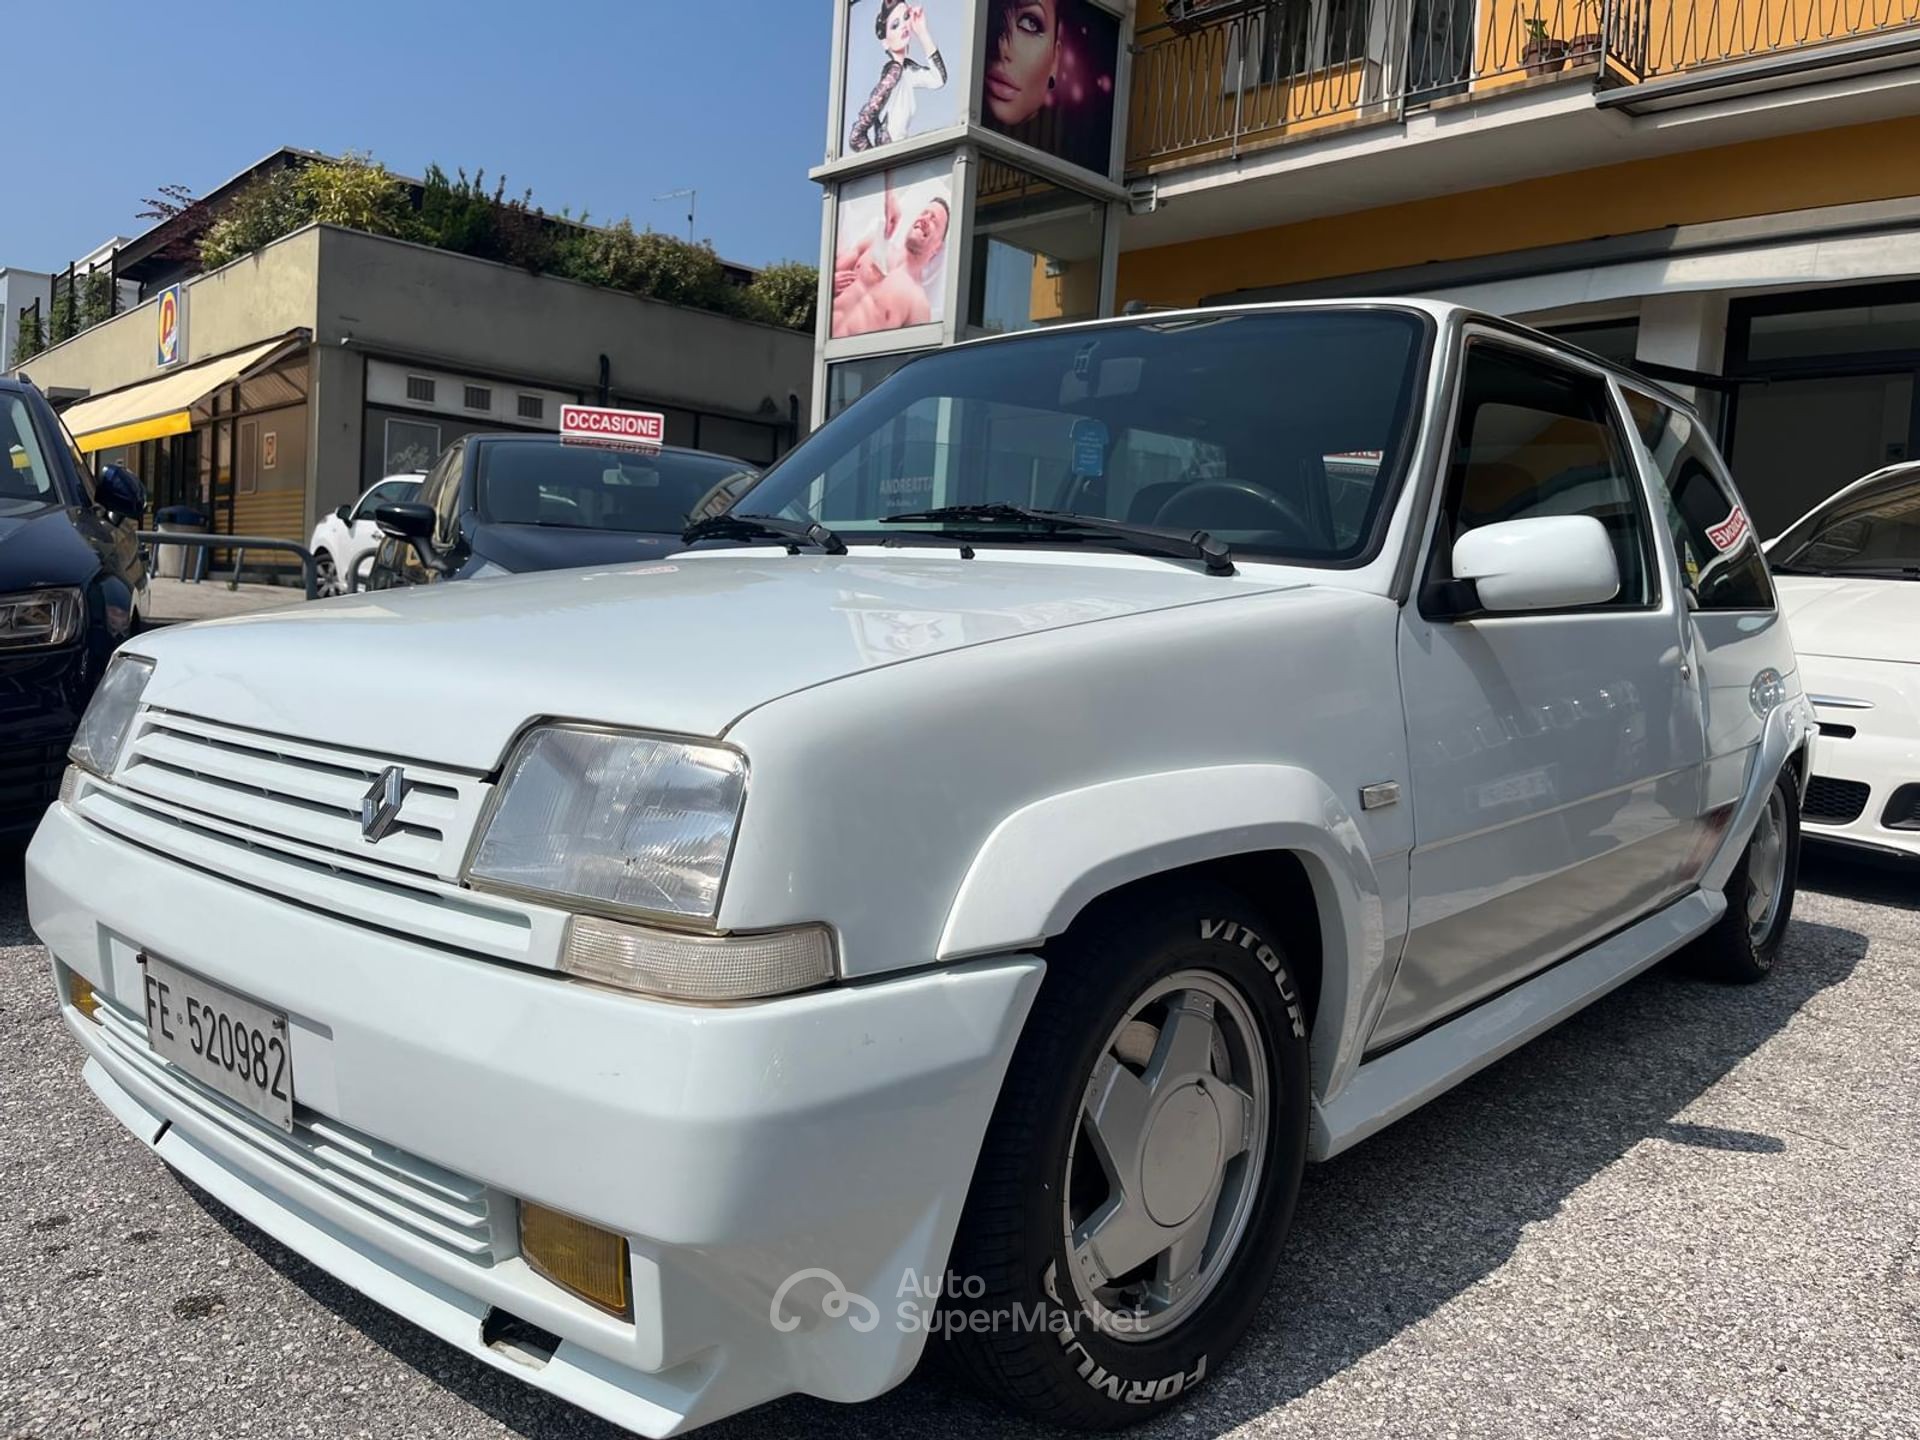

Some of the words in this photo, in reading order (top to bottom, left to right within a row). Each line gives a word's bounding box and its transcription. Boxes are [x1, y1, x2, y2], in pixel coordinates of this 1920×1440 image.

[566, 412, 658, 435] OCCASIONE
[145, 974, 174, 1041] FE
[186, 996, 287, 1102] 520982
[1200, 919, 1305, 1038] VITOUR
[1043, 1258, 1208, 1404] FORMULA
